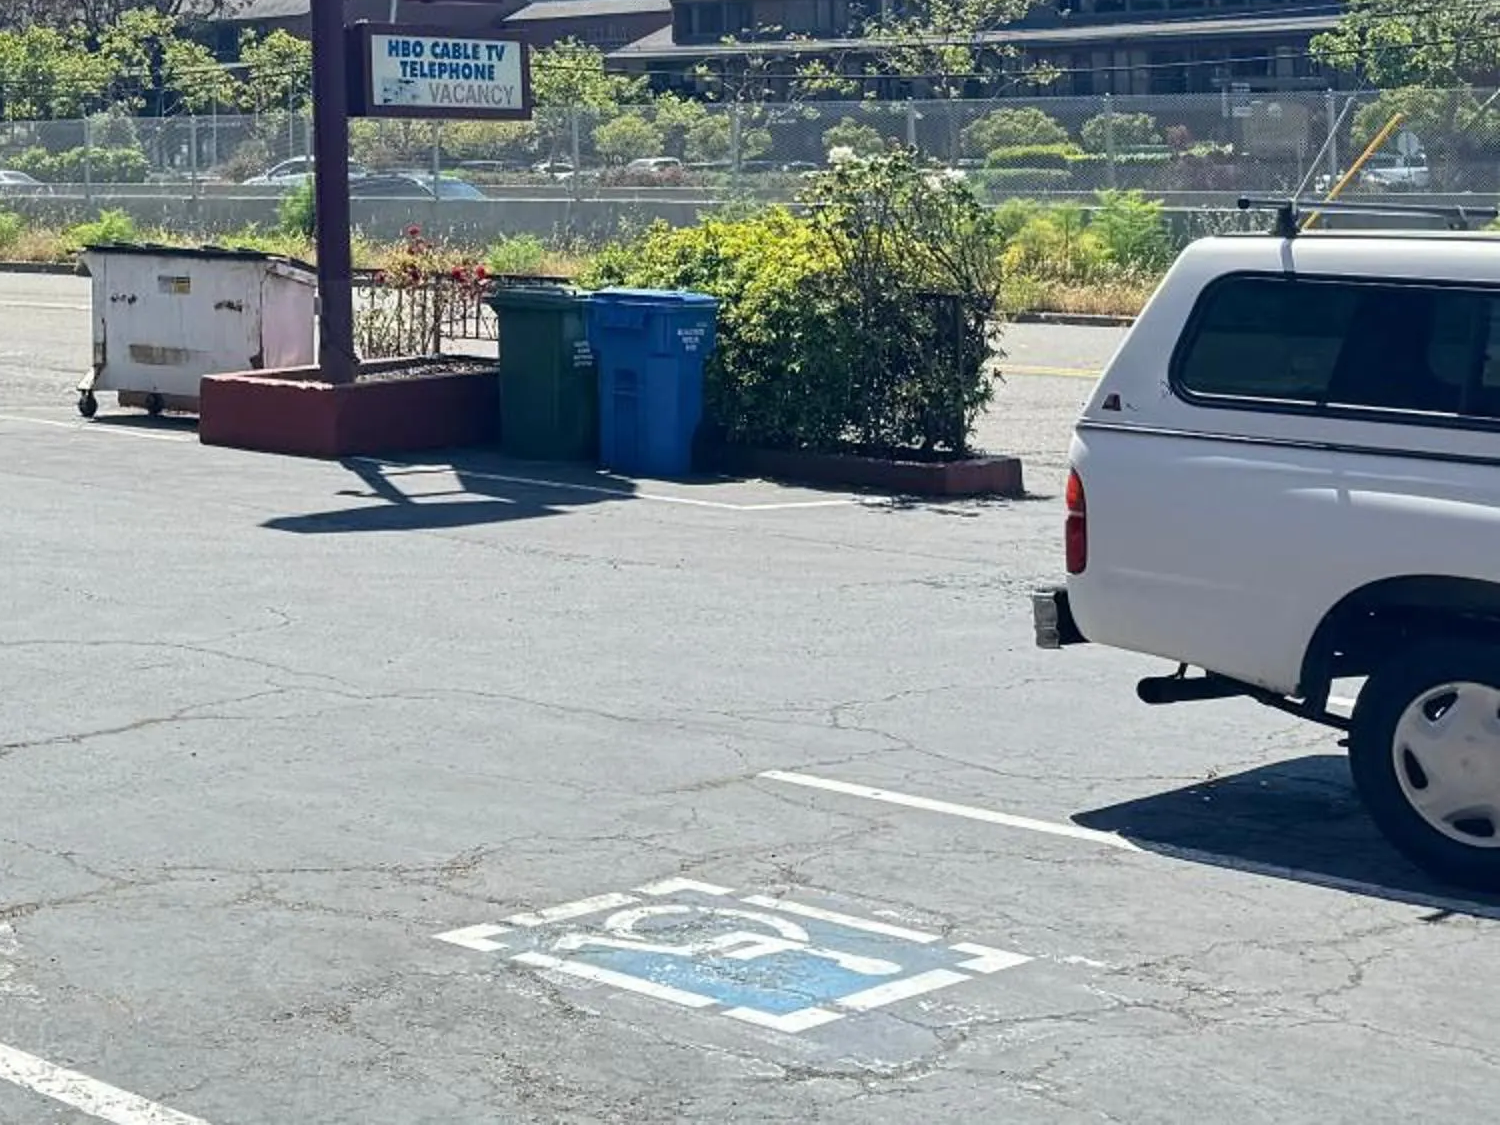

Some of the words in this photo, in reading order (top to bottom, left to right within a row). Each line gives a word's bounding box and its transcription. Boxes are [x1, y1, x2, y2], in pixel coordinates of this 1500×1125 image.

[388, 40, 424, 57] HBO
[430, 41, 480, 60] CABLE
[486, 44, 505, 62] TV
[400, 60, 495, 81] TELEPHONE
[429, 82, 515, 105] VACANCY
